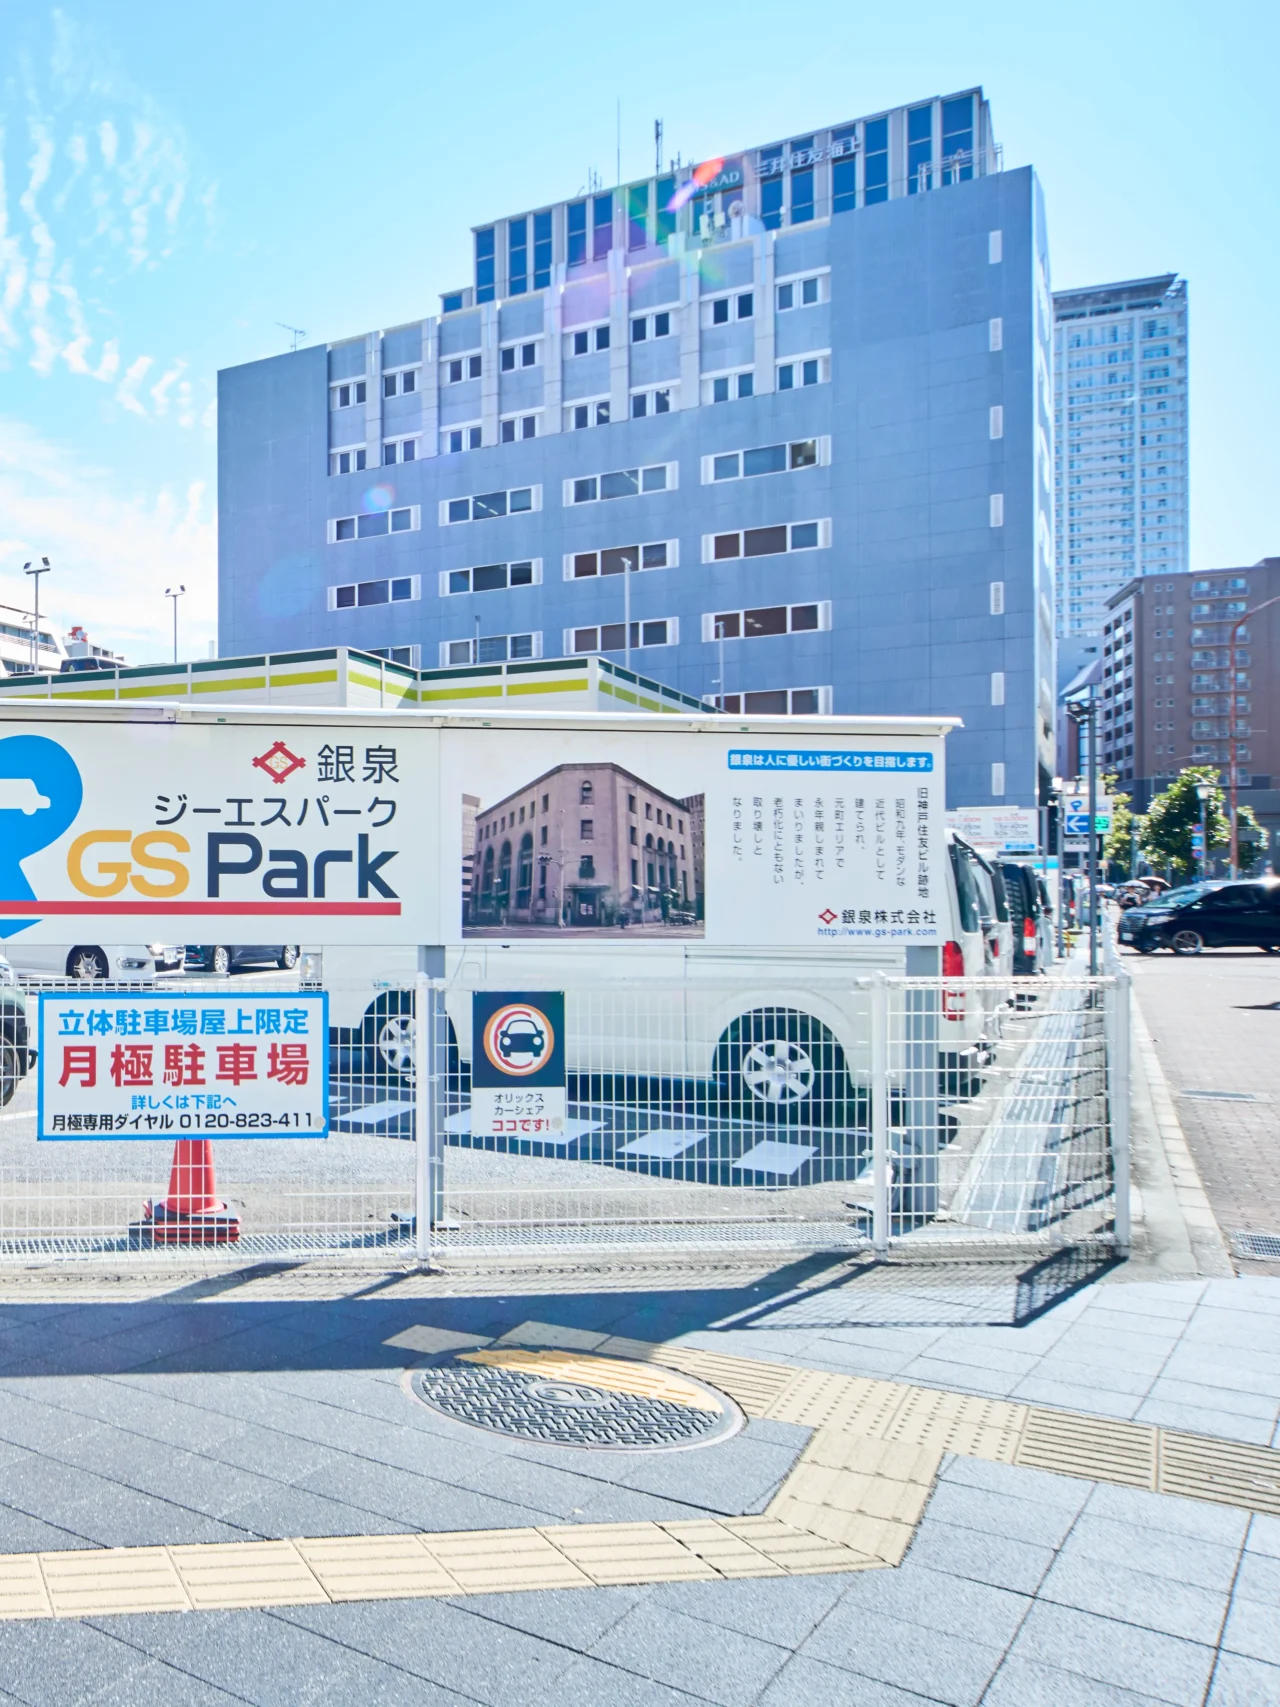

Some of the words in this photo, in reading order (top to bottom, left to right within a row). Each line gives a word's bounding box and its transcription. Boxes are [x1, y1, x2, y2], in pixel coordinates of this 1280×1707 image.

[754, 135, 862, 178] 三井住友海上
[317, 744, 400, 784] 銀泉
[729, 753, 932, 769] 銀泉は人に優しい街づくりを目指します。
[155, 794, 397, 828] ジーエスパーク
[66, 829, 191, 898] GS
[207, 832, 401, 899] Park
[841, 909, 937, 925] 銀泉株式会社
[817, 927, 937, 938] http://www.gs-park.com
[58, 1008, 310, 1036] 立体駐車場屋上限定
[58, 1042, 310, 1088] 月極駐車場
[131, 1094, 237, 1111] 詳しくは下記へ
[494, 1093, 544, 1104] オリックス
[494, 1105, 544, 1116] カーシェア
[52, 1113, 174, 1131] 月極専用ダイヤル
[179, 1112, 313, 1129] 0120-823-411
